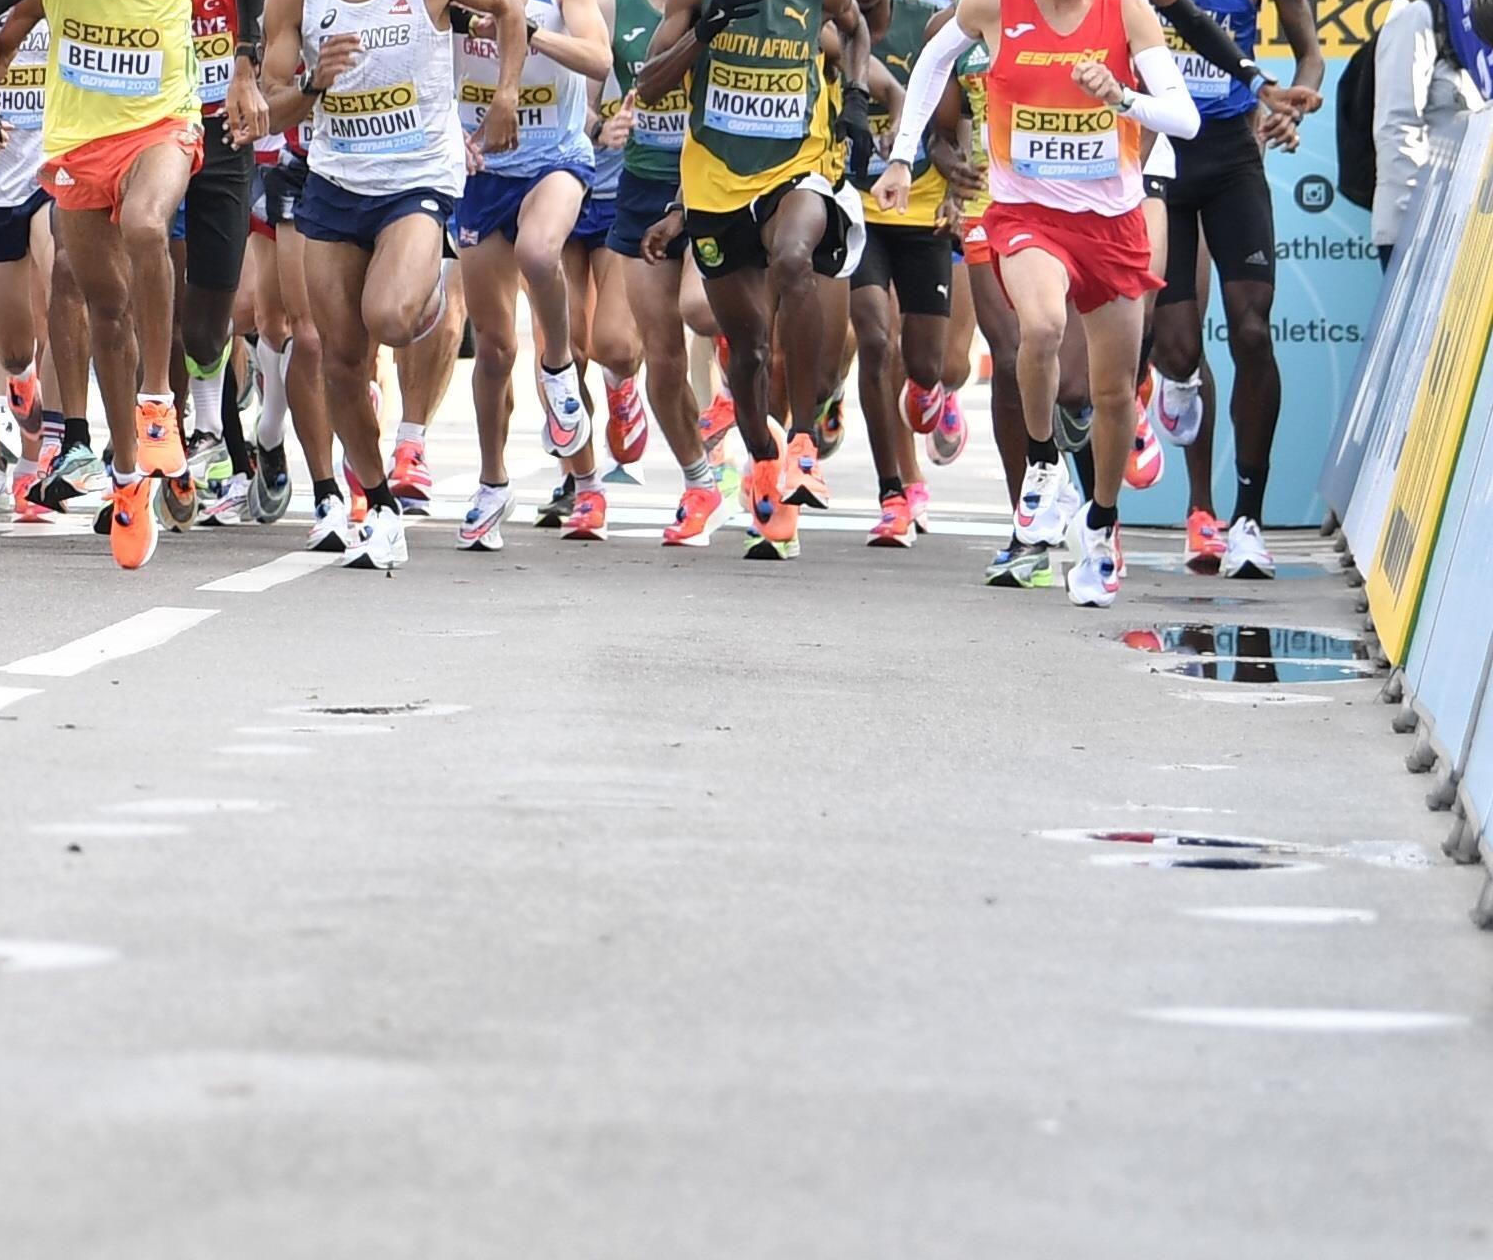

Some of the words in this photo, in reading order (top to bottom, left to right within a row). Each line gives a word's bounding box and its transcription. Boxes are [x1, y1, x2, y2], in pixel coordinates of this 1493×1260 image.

[63, 18, 160, 49] SEIKO
[361, 24, 411, 50] ANCE
[710, 32, 757, 57] SOUTH
[760, 37, 810, 61] AFRICA
[68, 45, 151, 76] BELIHU
[127, 78, 157, 91] 2020
[712, 66, 804, 93] SEIKO
[322, 87, 412, 114] SEIKO
[712, 90, 800, 119] MOKOKA
[329, 109, 417, 138] AMDOUNI
[474, 106, 543, 127] STH
[1015, 109, 1114, 134] SEIKO
[1029, 137, 1105, 161] PÉREZ
